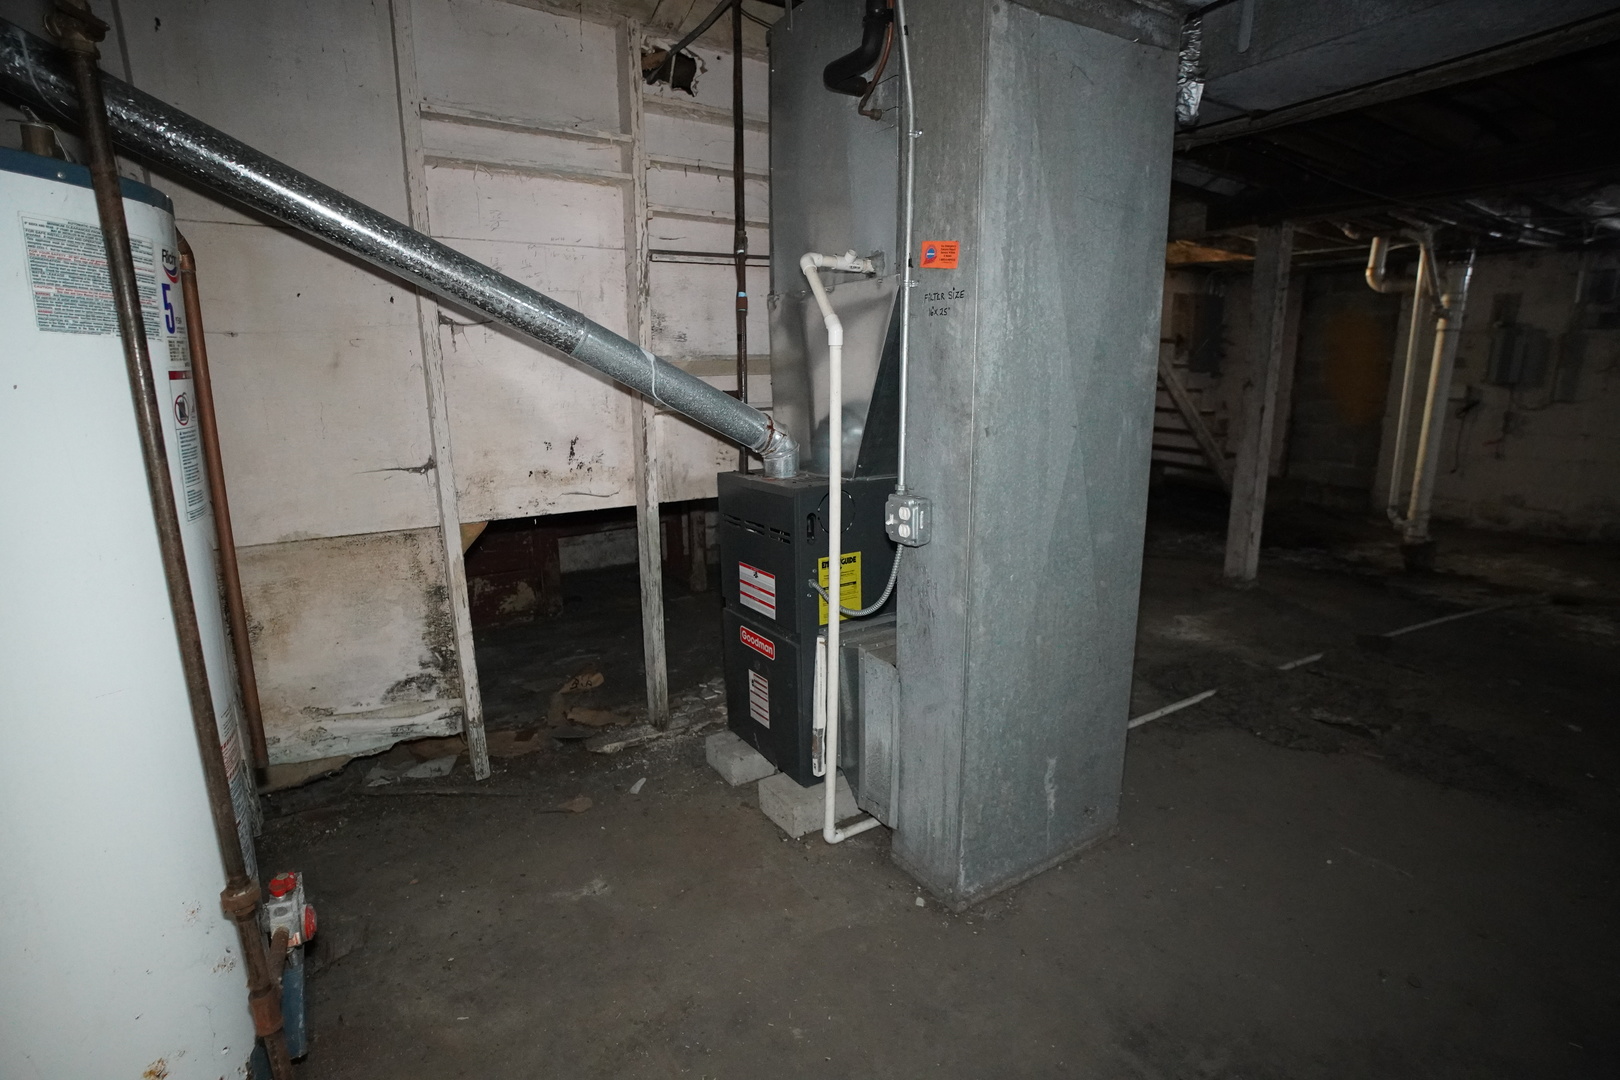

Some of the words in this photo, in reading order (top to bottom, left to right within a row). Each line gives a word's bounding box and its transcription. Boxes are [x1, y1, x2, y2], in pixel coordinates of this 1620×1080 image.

[924, 292, 945, 302] FILTER
[948, 287, 965, 299] SIZE
[162, 283, 175, 334] 5
[741, 630, 773, 655] Goodman
